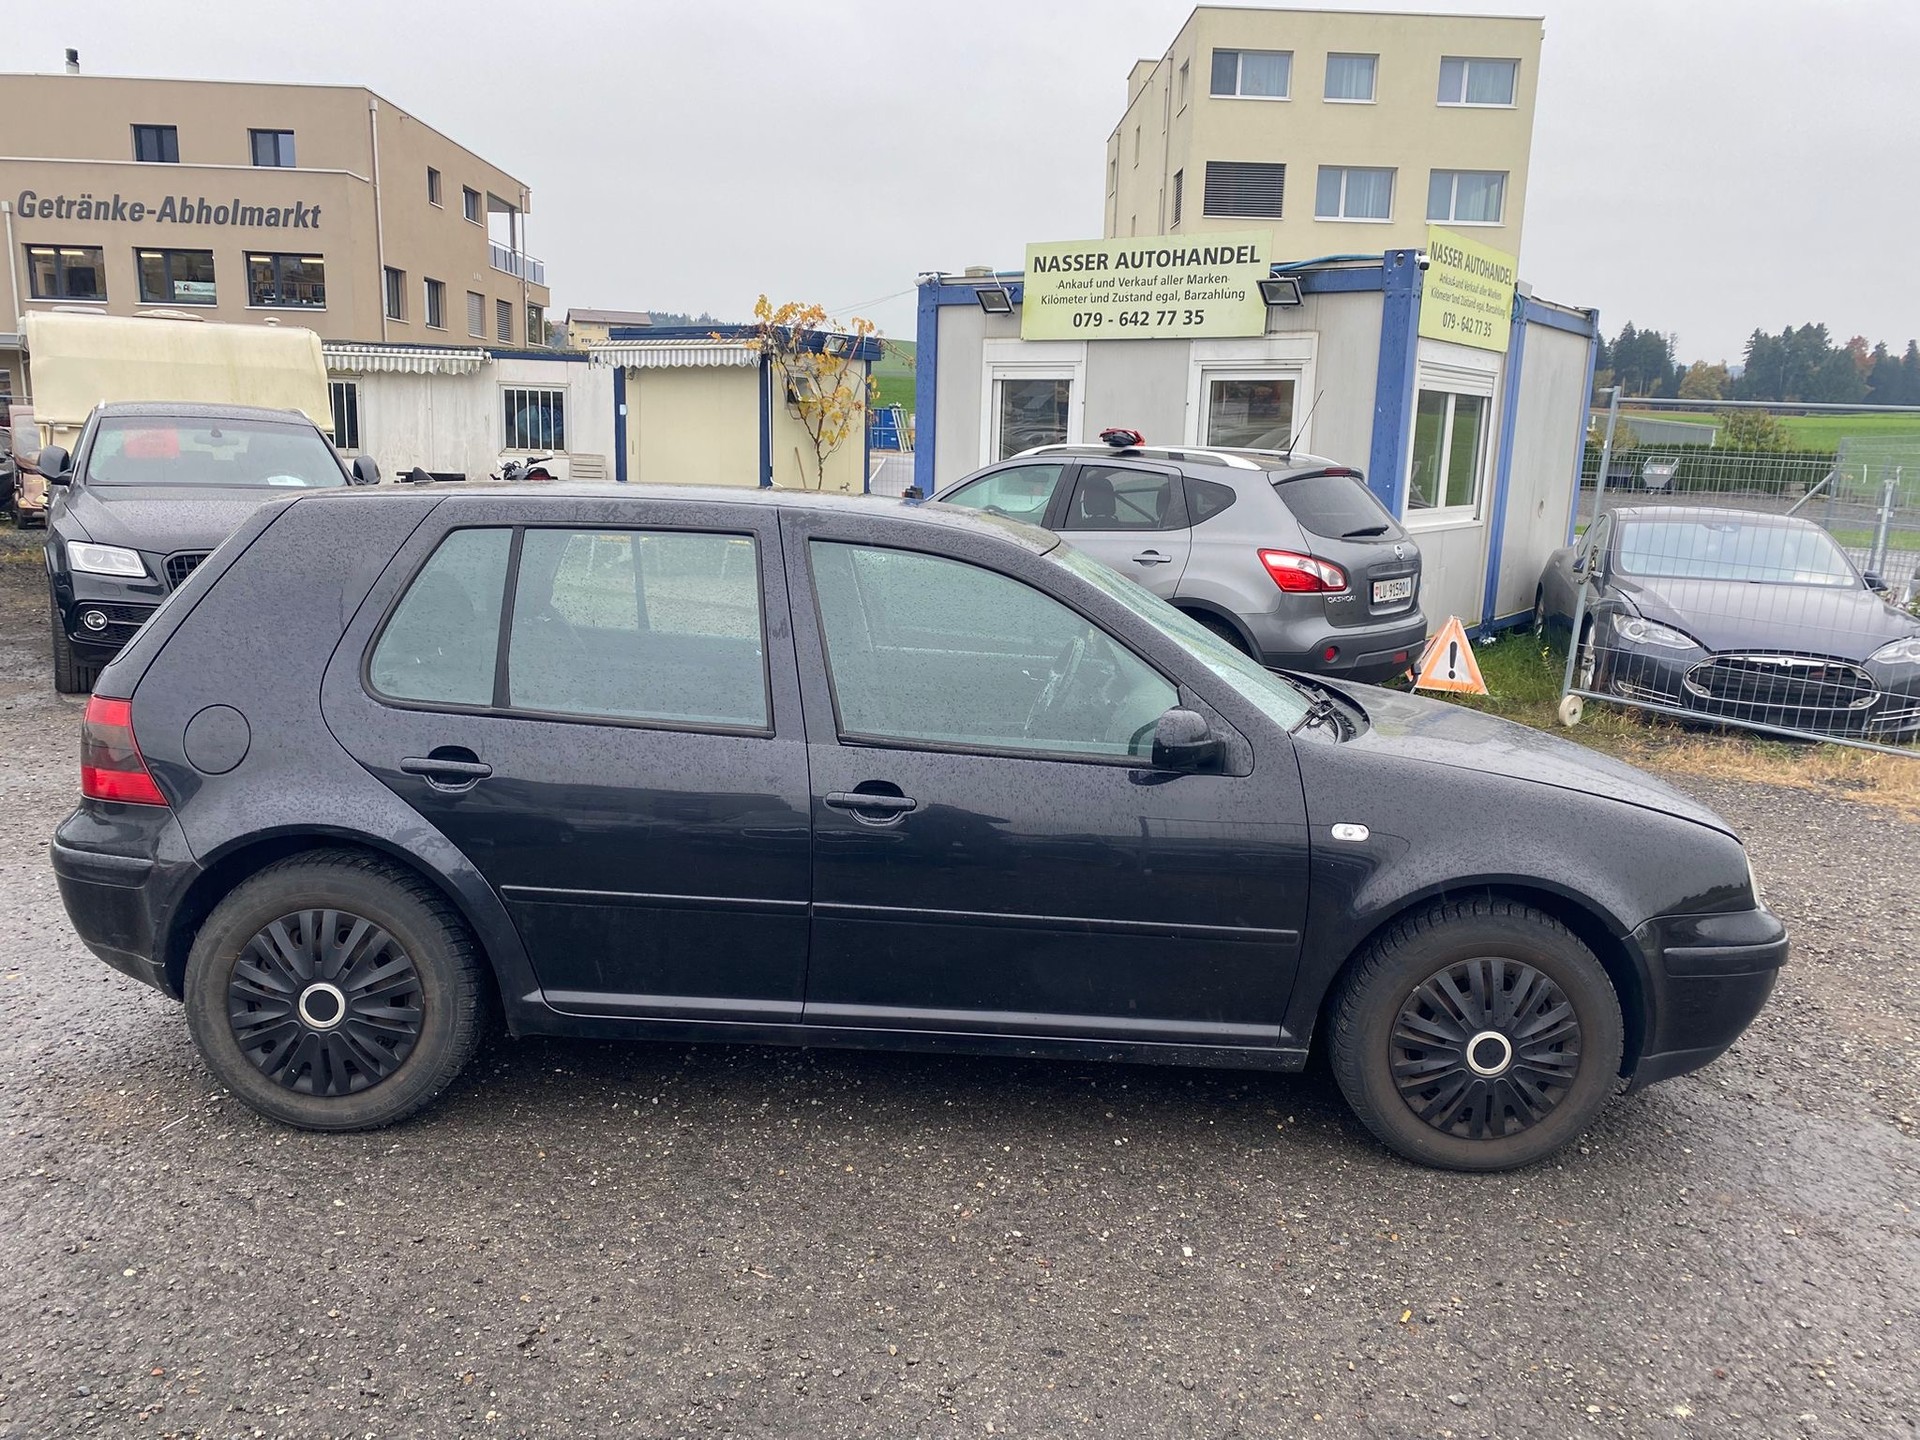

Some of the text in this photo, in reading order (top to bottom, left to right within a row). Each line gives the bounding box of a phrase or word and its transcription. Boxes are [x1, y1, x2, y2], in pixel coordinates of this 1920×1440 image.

[17, 190, 321, 228] Getränke-Abholmarkt
[1033, 245, 1261, 274] NASSER AUTOHANDEL
[1430, 241, 1513, 286] NASSER AUTOHANDEL
[1057, 274, 1228, 290] Ankauf und Verkauf aller Marken
[1041, 289, 1246, 305] Kilometer und Zustand egal, Barzahlung
[1073, 312, 1102, 327] 079
[1119, 311, 1150, 326] 642
[1156, 310, 1177, 326] 77
[1182, 309, 1205, 325] 35
[1442, 311, 1456, 329] 079
[1461, 316, 1473, 332] 642
[1474, 319, 1483, 335] 77
[1483, 321, 1492, 337] 35
